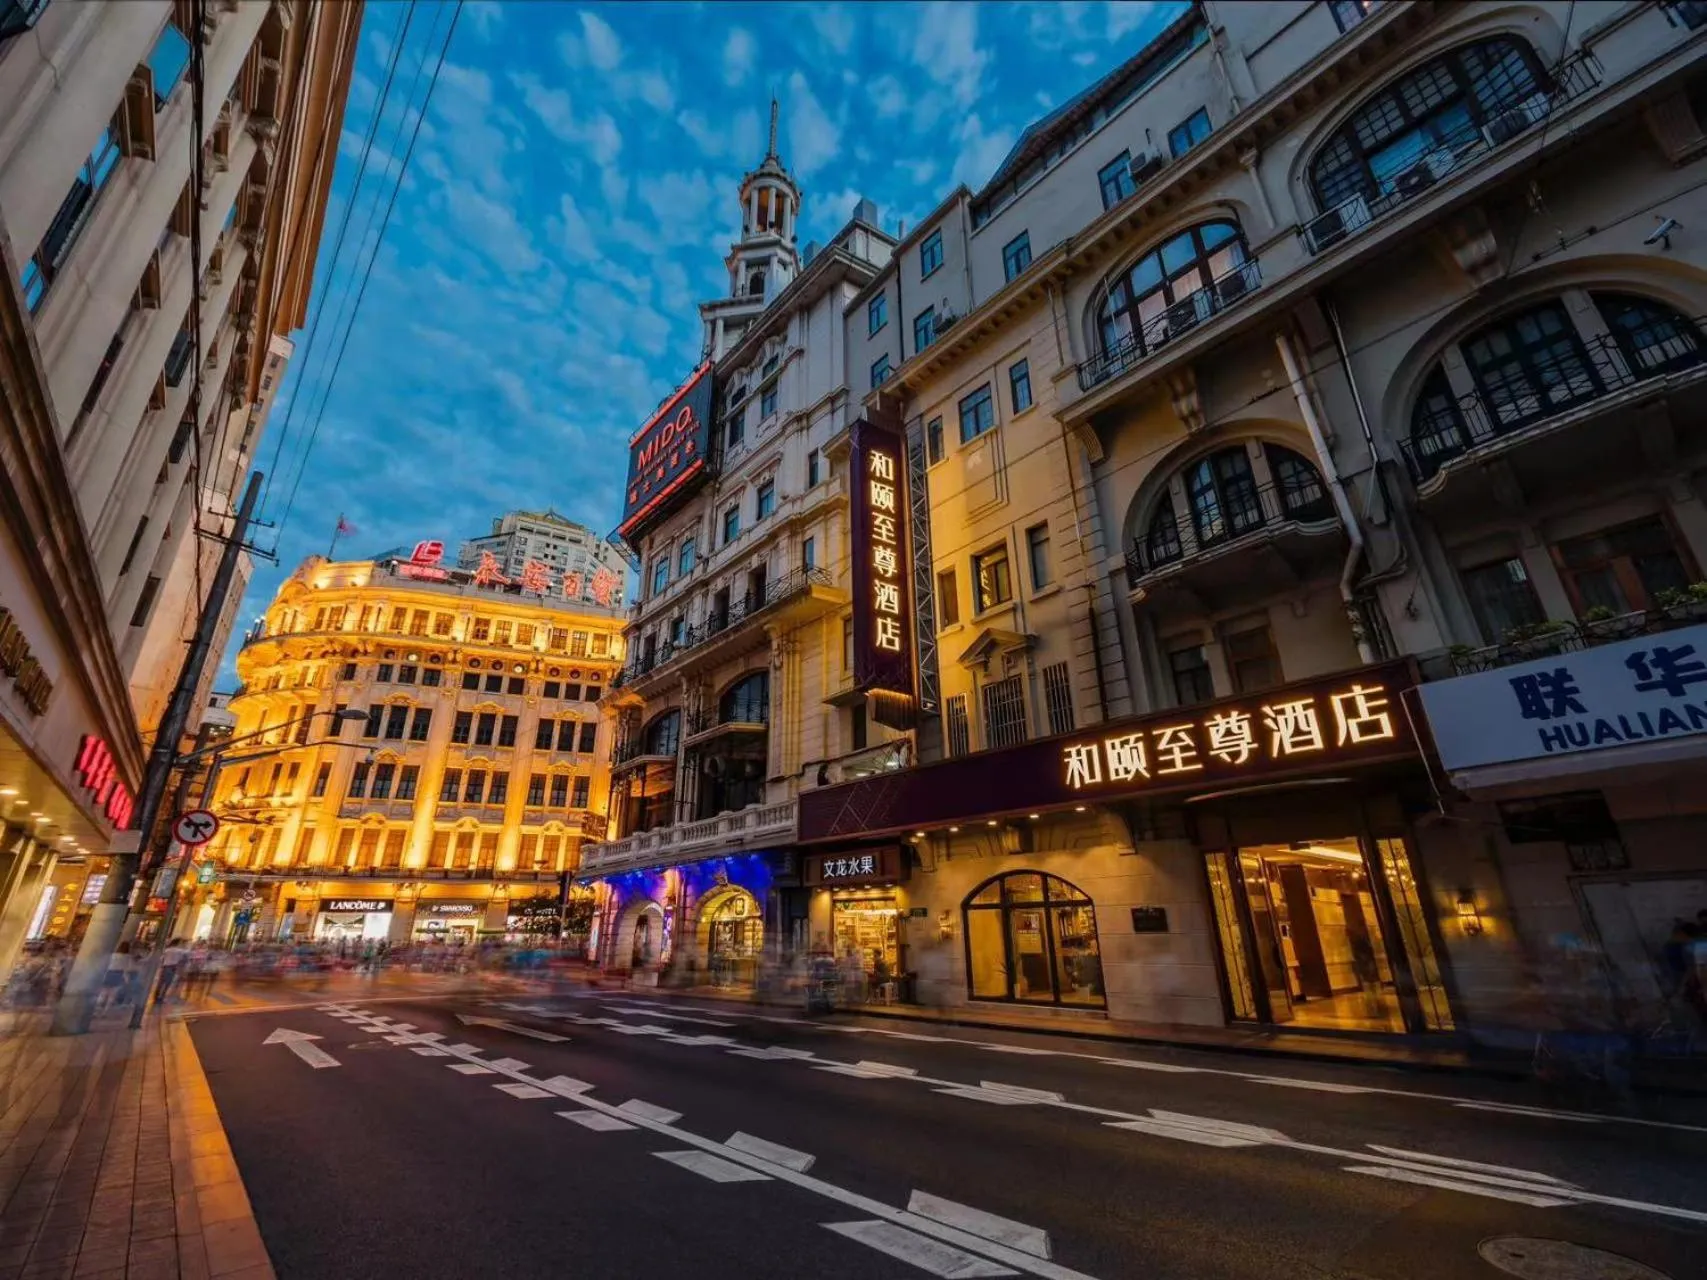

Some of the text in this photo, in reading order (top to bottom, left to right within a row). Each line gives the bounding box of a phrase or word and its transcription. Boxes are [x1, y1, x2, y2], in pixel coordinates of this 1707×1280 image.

[638, 406, 692, 470] MIDO
[870, 450, 900, 651] 和颐至尊酒店
[1509, 643, 1707, 720] 联华
[1064, 684, 1394, 789] 和颐至尊酒店
[823, 856, 873, 878] 文龙水果
